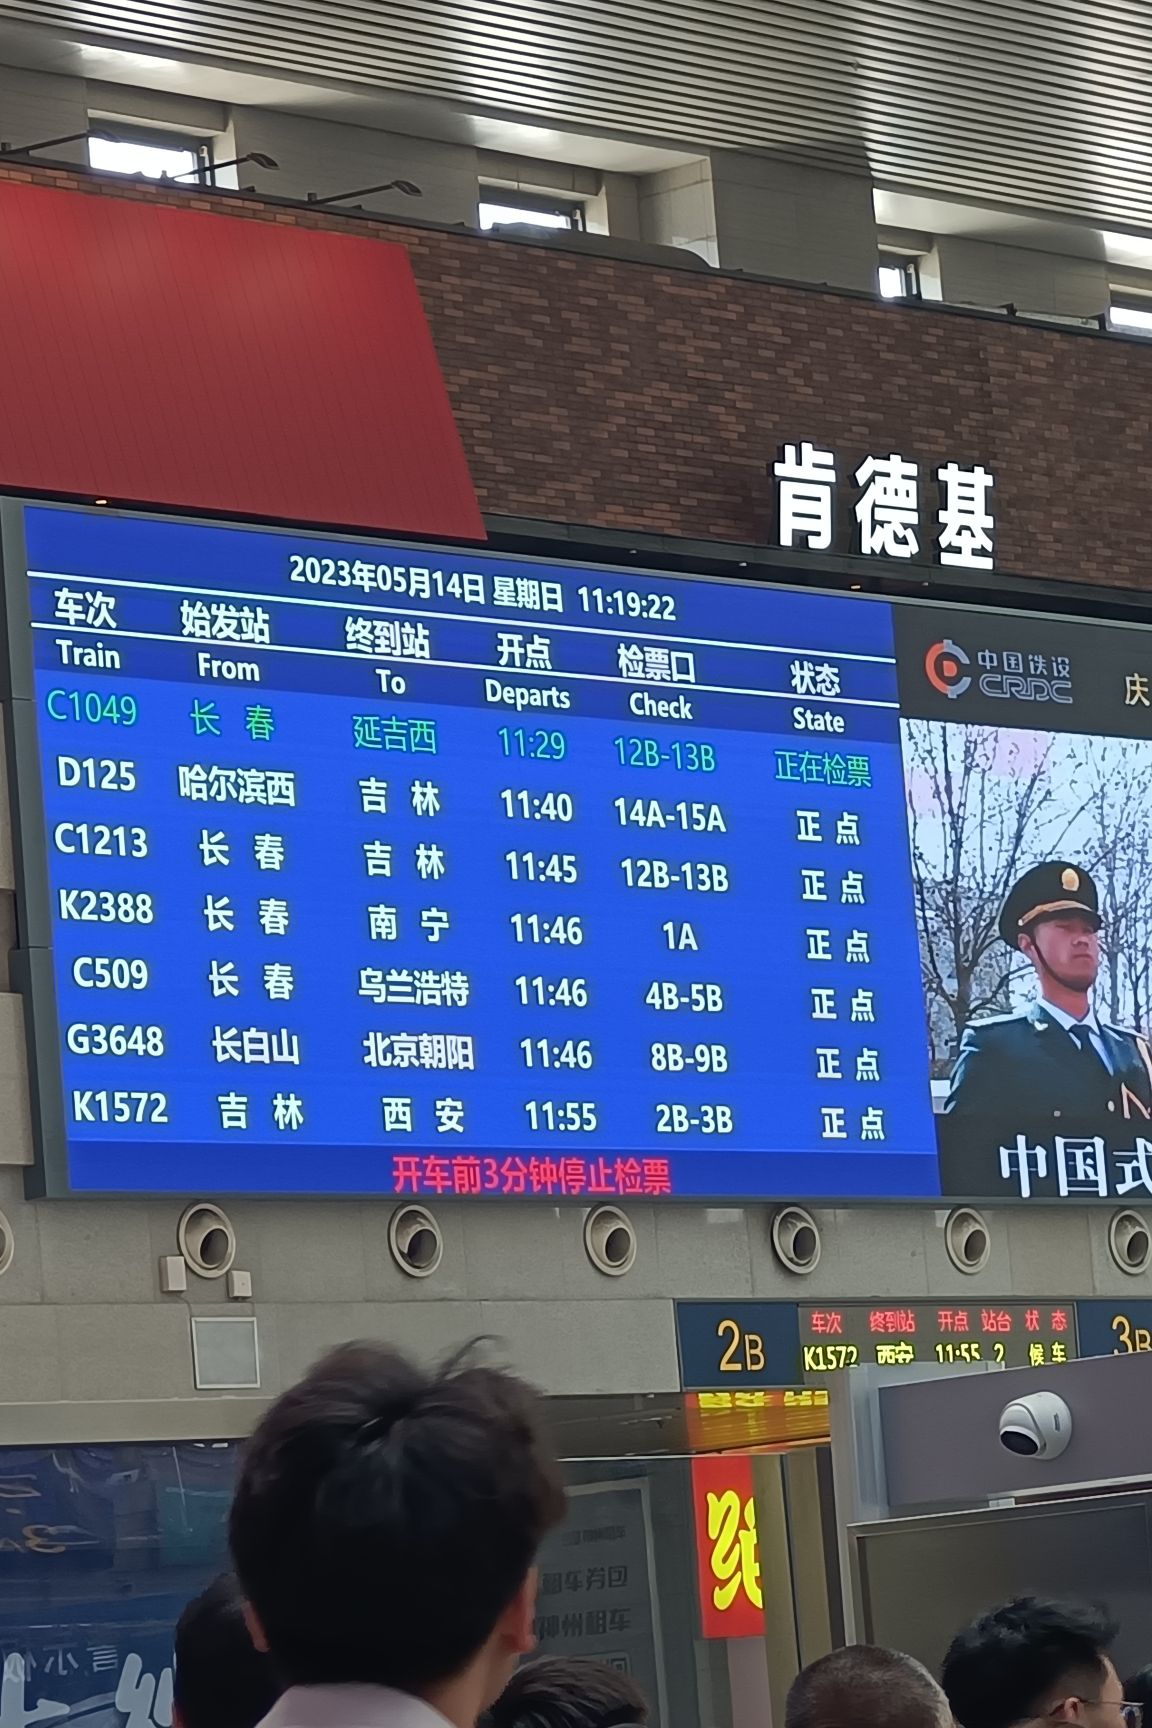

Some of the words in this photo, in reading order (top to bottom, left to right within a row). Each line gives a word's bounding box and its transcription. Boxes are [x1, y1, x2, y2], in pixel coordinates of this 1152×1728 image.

[773, 442, 994, 570] 肯德基
[289, 555, 486, 604] 2023年05月14日
[494, 577, 563, 612] 星期日
[578, 587, 676, 620] 11:19:22
[54, 588, 117, 628] 车次
[180, 600, 270, 644] 始发站
[344, 617, 430, 658] 终到站
[497, 632, 552, 670] 开点
[618, 643, 696, 683] 检票口
[790, 661, 841, 697] 状态
[56, 639, 120, 668] Train
[198, 653, 259, 681] From
[376, 669, 405, 694] To
[486, 679, 570, 711] Departs
[630, 692, 692, 719] Check
[794, 707, 844, 732] State
[979, 673, 1074, 704] CRDC
[48, 690, 136, 724] C1049
[191, 700, 274, 740] 长春
[353, 716, 436, 753] 延吉西
[499, 728, 564, 759] 11:29
[615, 738, 714, 771] 12B-13B
[775, 751, 871, 787] 正在检票
[59, 757, 135, 790] D125
[179, 764, 295, 806] 哈尔滨西
[359, 777, 440, 816] 吉林
[502, 790, 572, 821] 11:40
[615, 798, 726, 832] 14A-15A
[797, 811, 859, 845] 正点
[55, 823, 147, 857] C1213
[200, 830, 284, 870] 长春
[364, 841, 444, 879] 吉林
[506, 852, 577, 883] 11:45
[622, 859, 728, 891] 12B-13B
[802, 870, 864, 903] 正点
[60, 890, 153, 923] K2388
[204, 895, 288, 934] 长春
[368, 905, 449, 941] 南宁
[511, 914, 582, 944] 11:46
[663, 922, 698, 950] 1A
[807, 929, 869, 962] 正点
[74, 957, 147, 989] C509
[209, 961, 293, 999] 长春
[359, 968, 469, 1006] 乌兰浩特
[516, 976, 587, 1006] 11:46
[646, 982, 722, 1011] 4B-5B
[812, 989, 874, 1021] 正点
[68, 1024, 163, 1056] G3648
[213, 1026, 299, 1064] 长白山
[363, 1032, 474, 1069] 北京朝阳
[521, 1039, 592, 1068] 11:46
[652, 1043, 727, 1072] 8B-9B
[816, 1048, 879, 1080] 正点
[74, 1091, 167, 1122] K1572
[218, 1092, 303, 1129] 吉林
[383, 1098, 463, 1132] 西安
[526, 1101, 596, 1130] 11:55
[657, 1105, 732, 1133] 2B-3B
[822, 1107, 884, 1140] 正点
[392, 1155, 673, 1195] 开车前3分钟停止检票
[717, 1320, 765, 1371] 2B
[811, 1310, 842, 1334] 车次
[870, 1309, 916, 1334] 终到站
[938, 1310, 969, 1332] 开点
[981, 1308, 1012, 1333] 站台
[1024, 1308, 1068, 1332] 状态
[1112, 1315, 1152, 1356] 3B
[804, 1343, 858, 1371] K1572
[876, 1341, 915, 1364] 西安
[936, 1343, 983, 1364] 11:55
[1028, 1342, 1067, 1366] 候车
